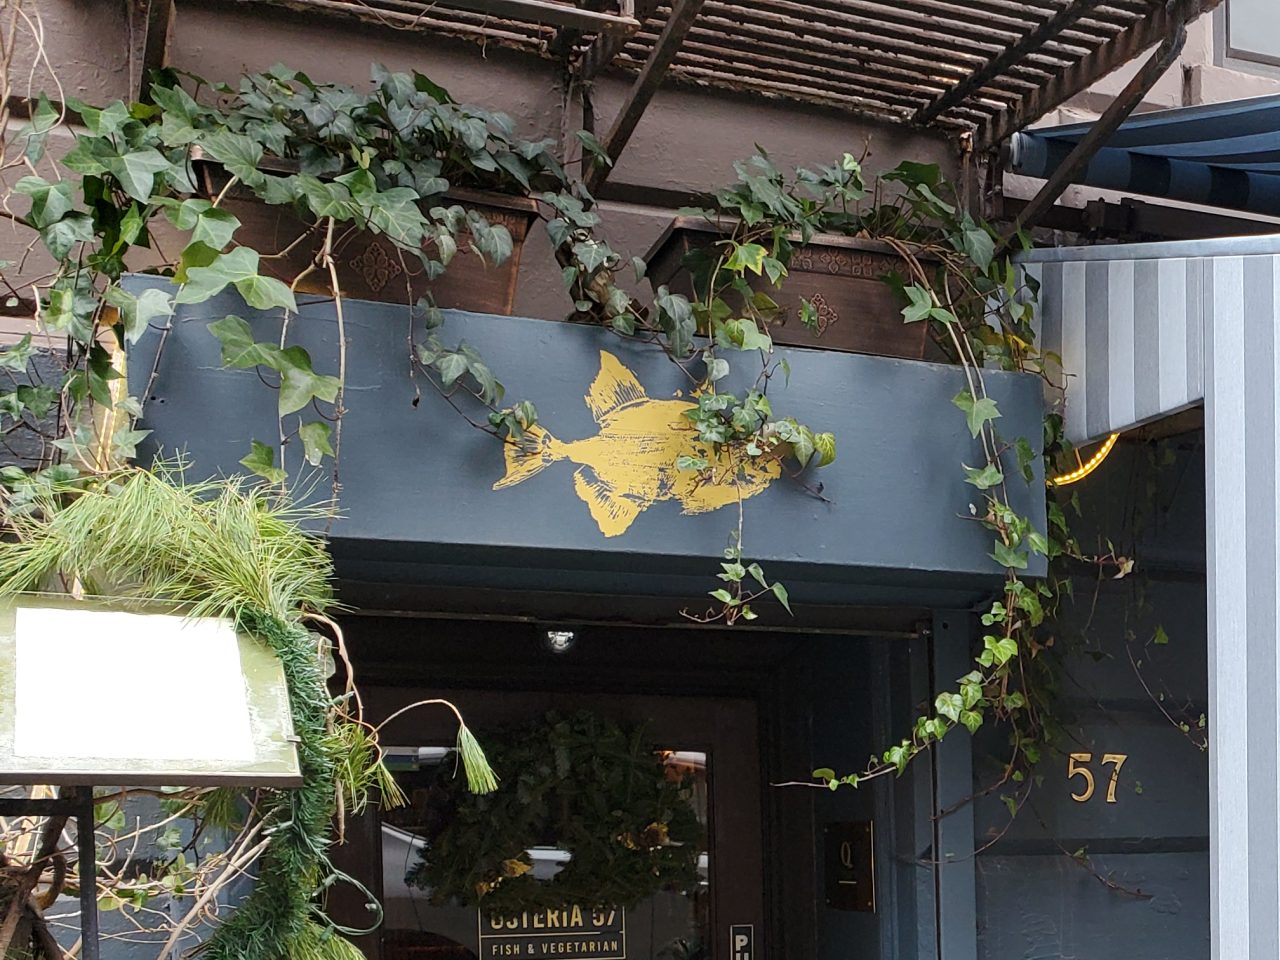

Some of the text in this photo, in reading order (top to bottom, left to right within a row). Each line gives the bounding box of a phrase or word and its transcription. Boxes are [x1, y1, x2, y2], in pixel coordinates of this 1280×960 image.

[1068, 753, 1128, 803] 57
[492, 941, 618, 956] FISH & VEGETARIAN
